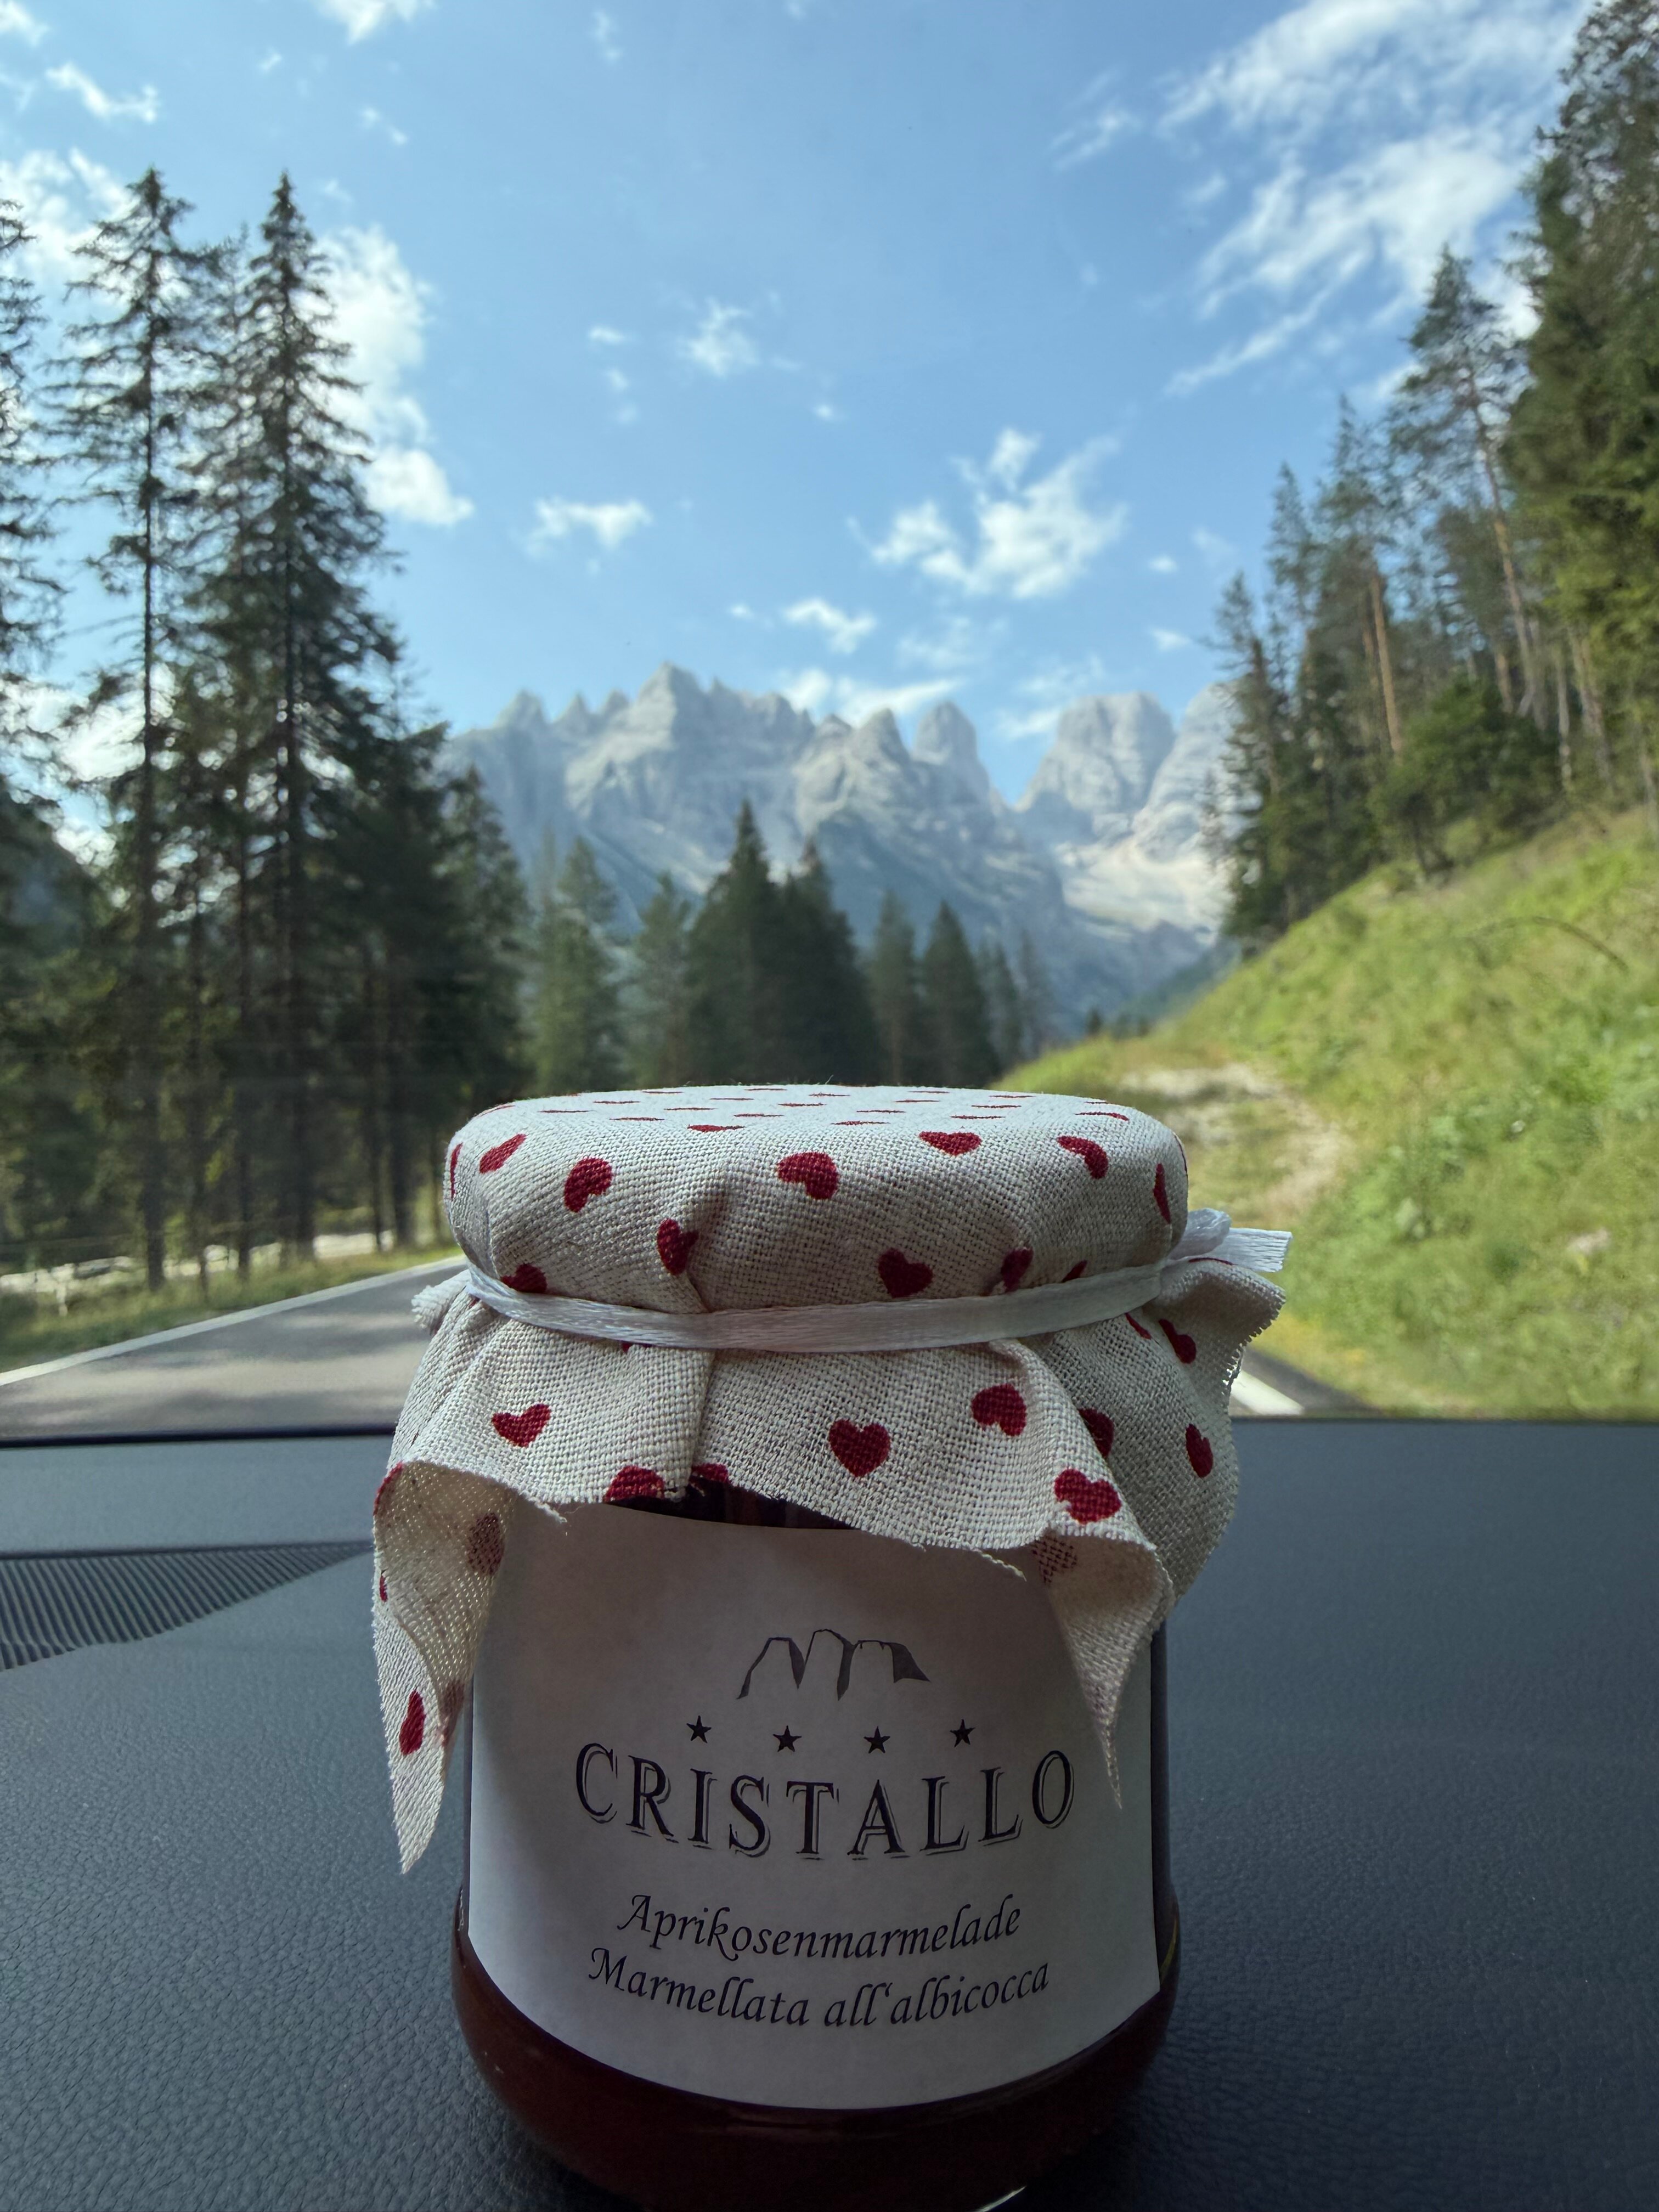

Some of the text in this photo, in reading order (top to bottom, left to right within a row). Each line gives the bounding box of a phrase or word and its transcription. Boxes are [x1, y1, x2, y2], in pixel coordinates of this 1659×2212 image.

[575, 1742, 1074, 1860] CRISTALLO
[617, 1894, 1021, 1961] Aprikosenmarmelade
[588, 1947, 809, 2026] Marmellata
